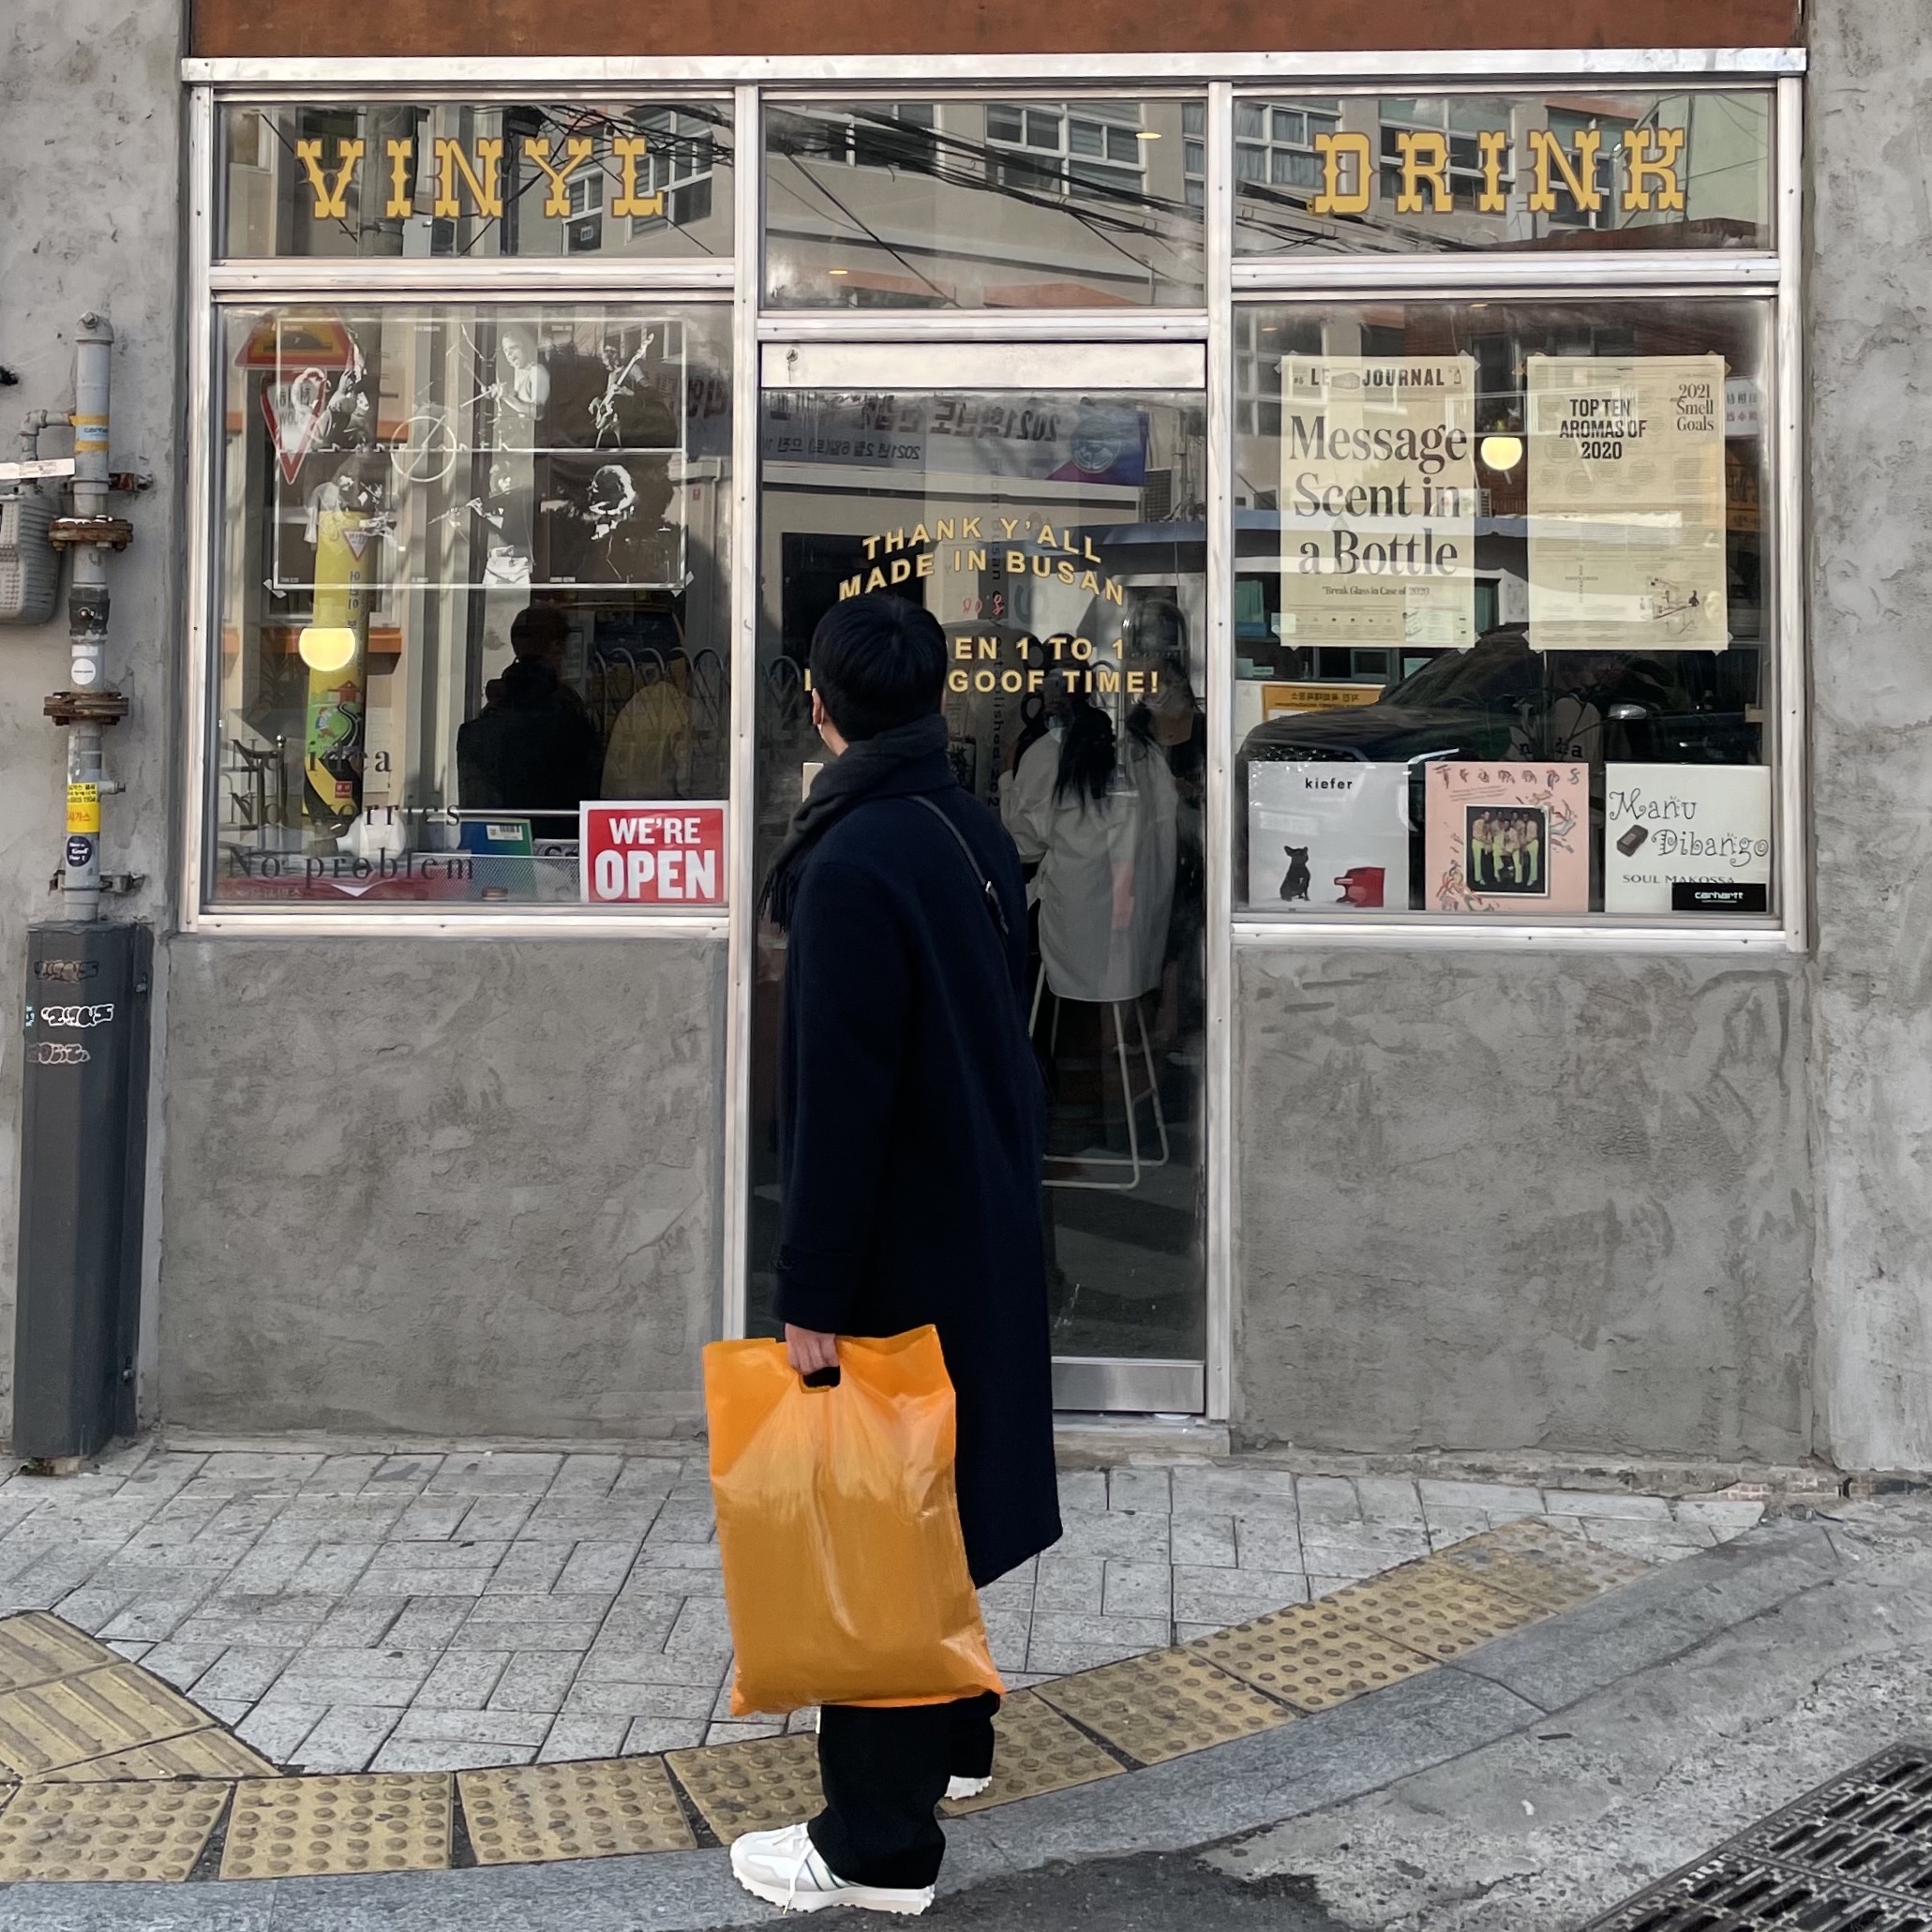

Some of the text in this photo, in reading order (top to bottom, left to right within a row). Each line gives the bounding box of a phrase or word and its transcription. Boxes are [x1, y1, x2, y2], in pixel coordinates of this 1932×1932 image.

[296, 138, 664, 219] VINYL
[1314, 127, 1686, 215] DRINK
[1362, 367, 1445, 387] JOURNAL
[1678, 382, 1711, 399] 2021
[1569, 398, 1631, 417] TOP TEN
[1675, 400, 1715, 415] Smell
[1559, 420, 1625, 439] AROMAS
[1676, 415, 1715, 432] Goals
[1289, 414, 1468, 474] Message
[1580, 441, 1623, 459] 2020
[1294, 471, 1461, 519] Scent in
[861, 517, 1102, 563] THANK Y'ALL
[1299, 527, 1459, 576] a Bottle
[838, 548, 1124, 607] MADE IN BUSAN
[953, 636, 998, 661] EN
[1015, 637, 1029, 661] 1
[1049, 637, 1093, 661] TO
[948, 668, 1160, 694] GOOF TIME!
[1305, 777, 1353, 789] kiefer
[309, 794, 460, 827] orries
[1609, 787, 1698, 821] Manu
[608, 816, 701, 845] WE'RE
[1651, 829, 1769, 868] Dibango
[229, 846, 474, 889] No problem
[594, 849, 716, 900] OPEN
[1623, 874, 1663, 884] SOUL
[1694, 891, 1745, 900] carhartt
